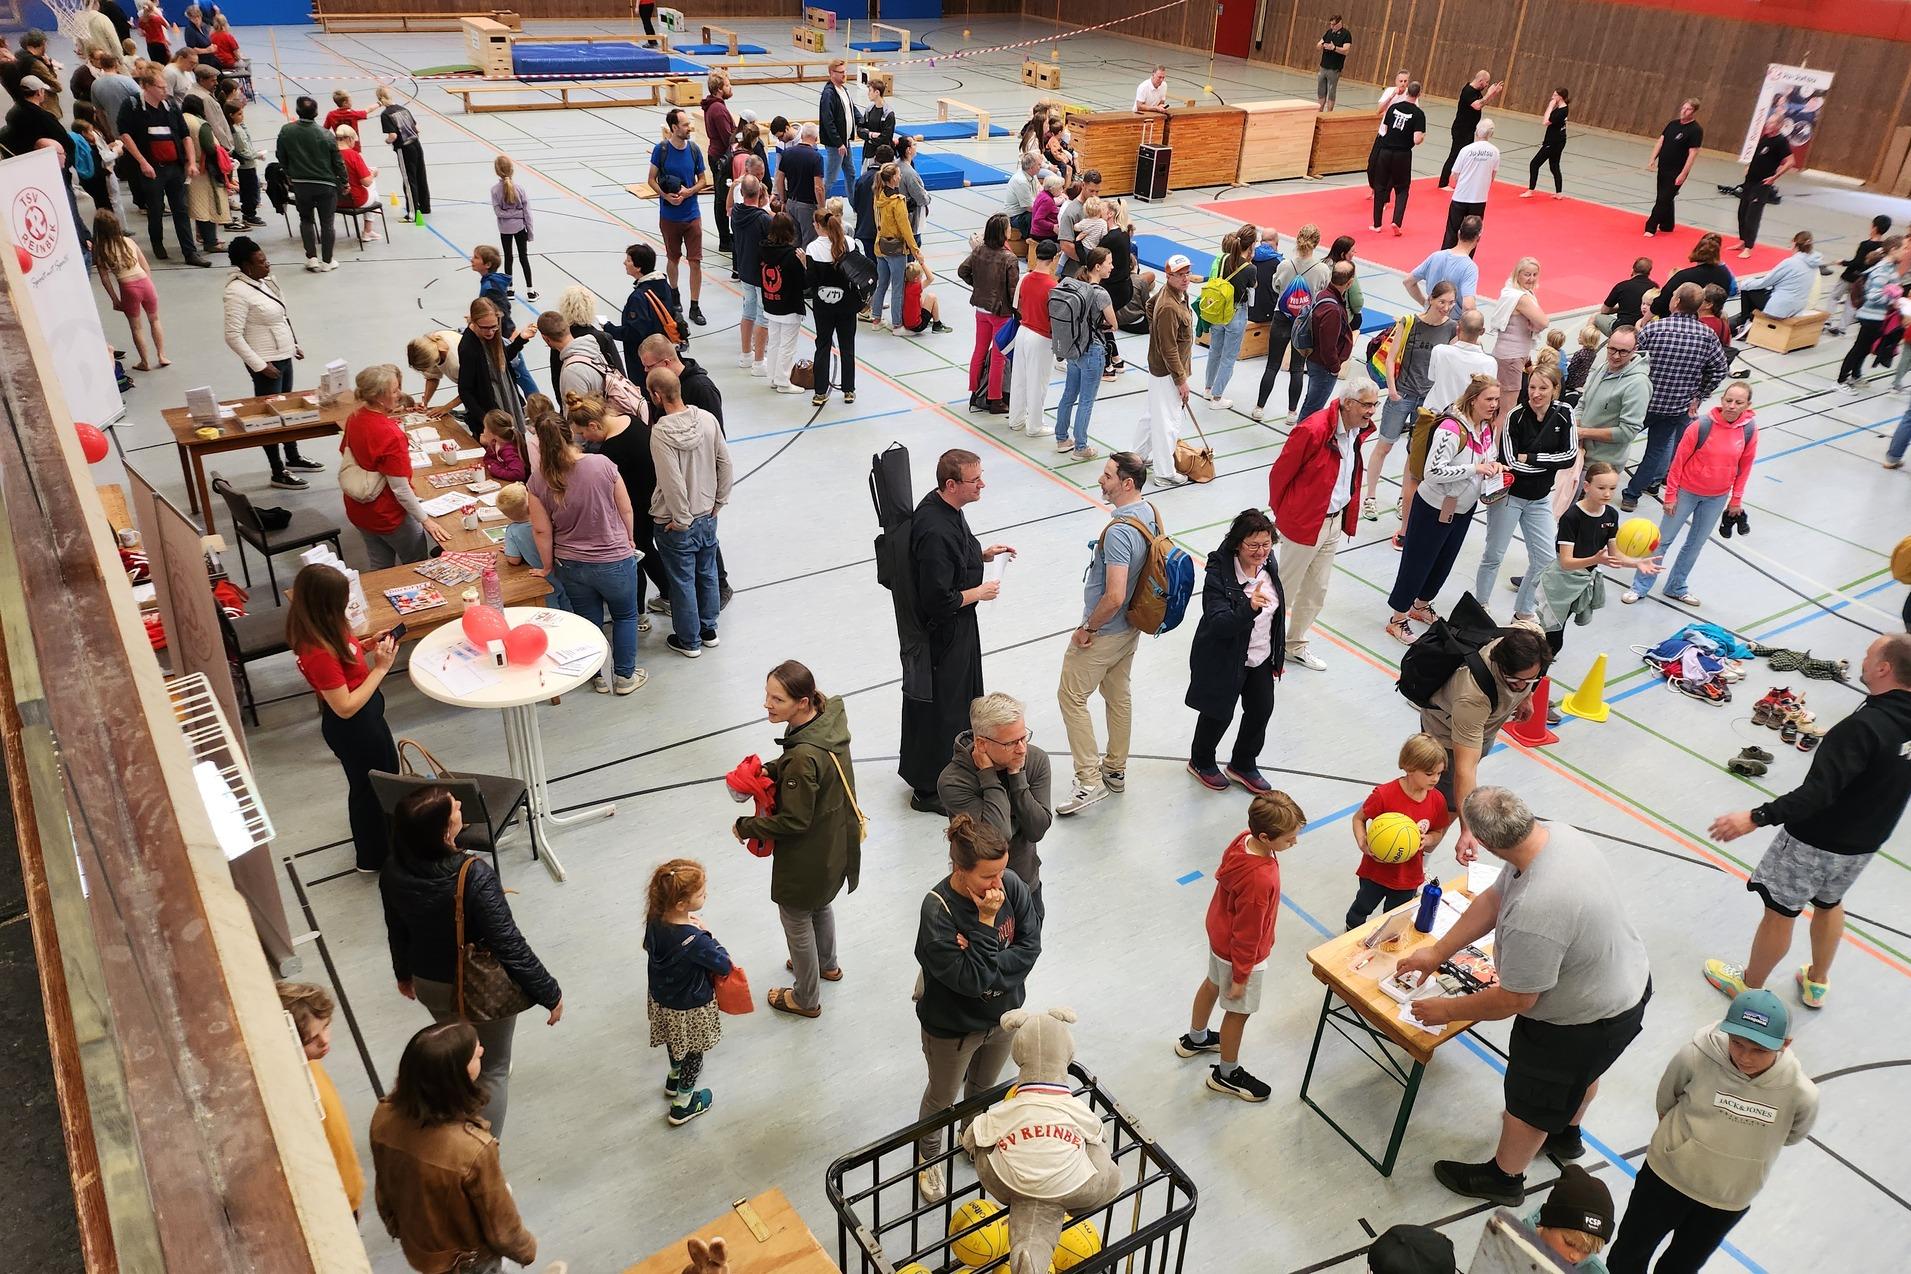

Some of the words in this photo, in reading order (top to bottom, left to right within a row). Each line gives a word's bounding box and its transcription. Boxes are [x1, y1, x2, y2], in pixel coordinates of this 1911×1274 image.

[19, 191, 39, 208] TSV
[22, 223, 56, 254] REINBEK
[998, 1133, 1016, 1153] SV
[1020, 1124, 1081, 1150] REINBE
[1585, 1216, 1602, 1227] FCSP
